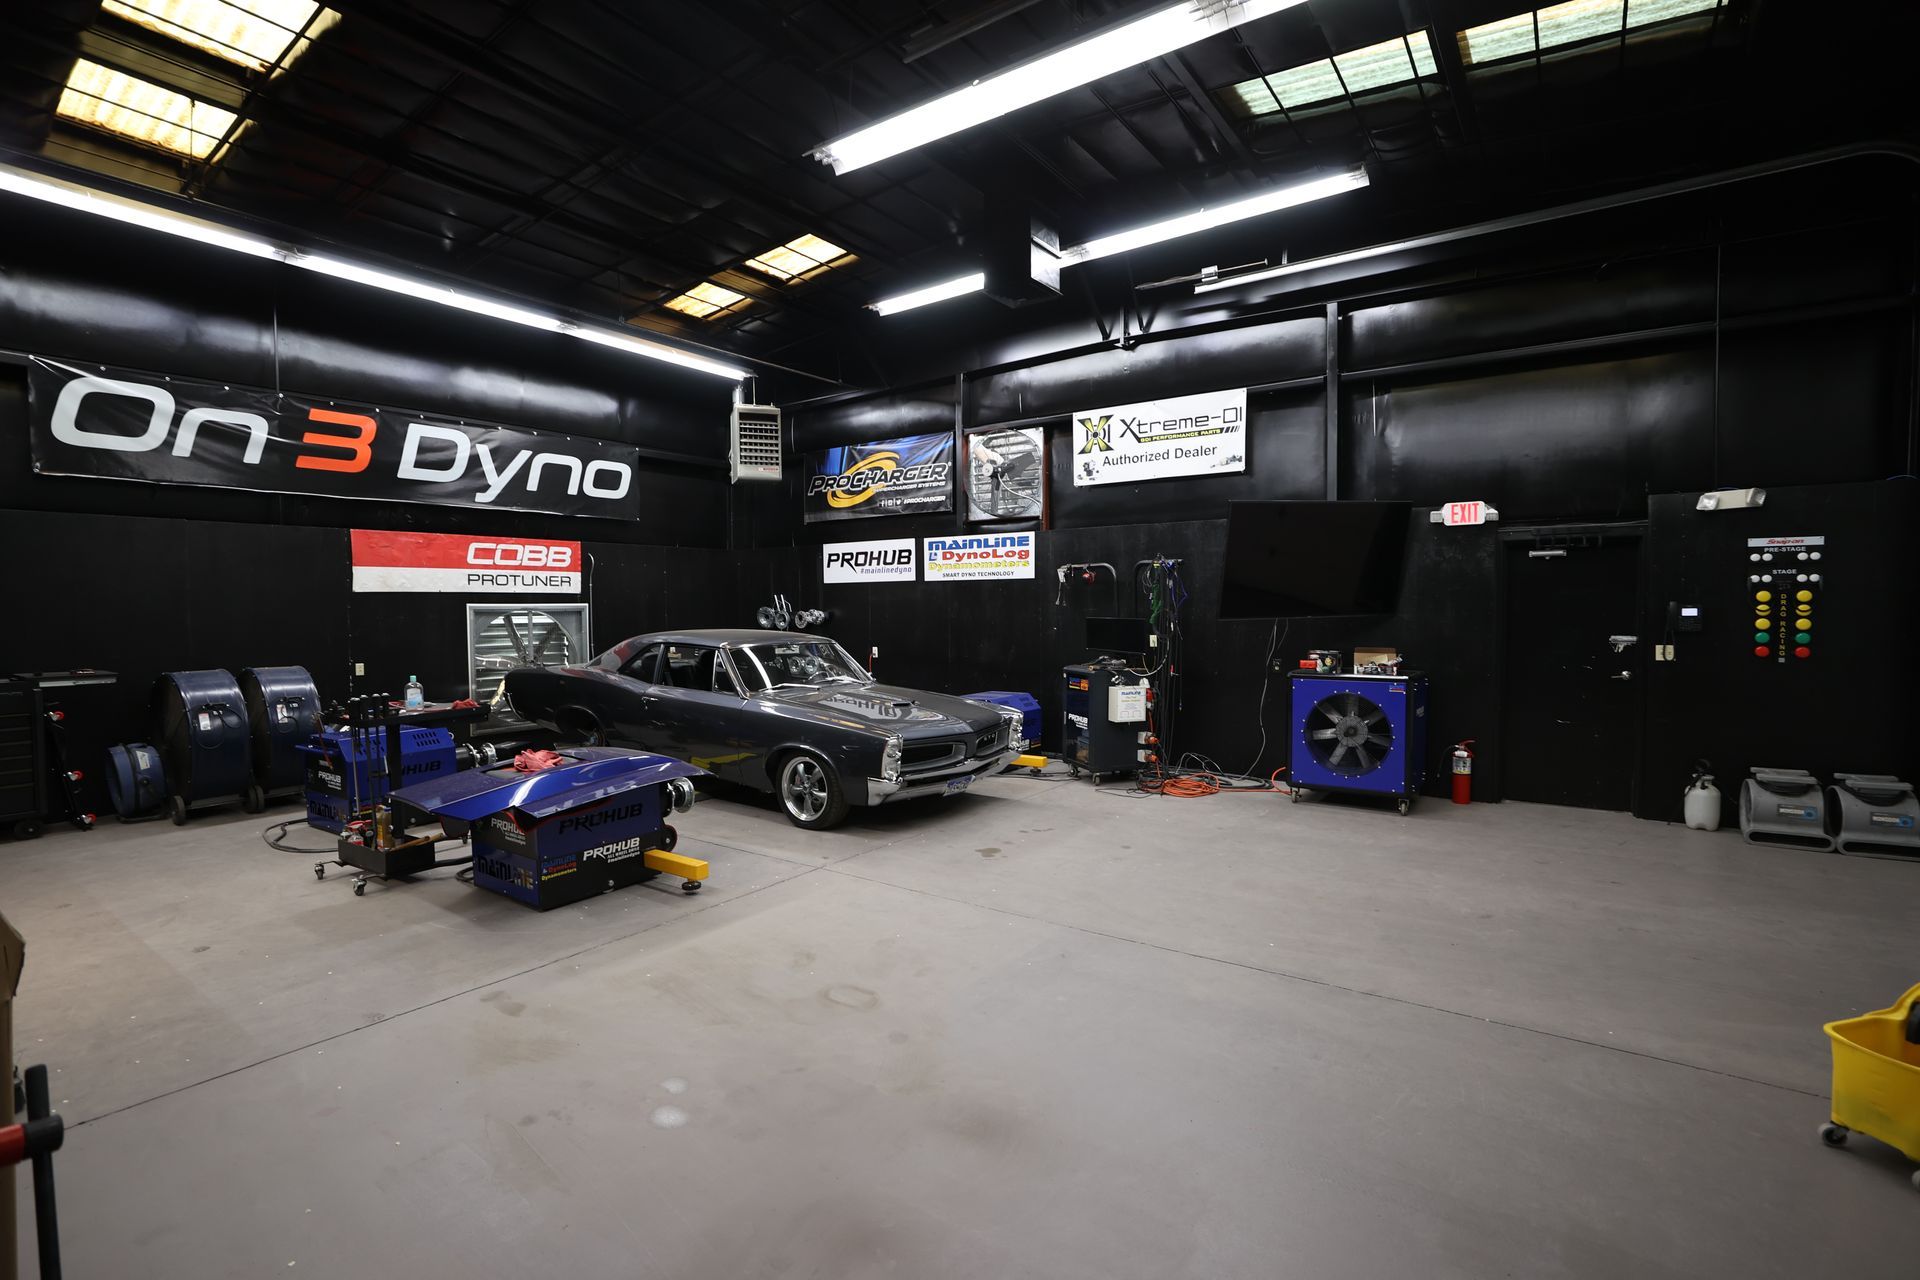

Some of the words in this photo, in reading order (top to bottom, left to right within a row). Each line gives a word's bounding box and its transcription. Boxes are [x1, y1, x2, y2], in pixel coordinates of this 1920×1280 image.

[51, 377, 269, 465] On
[295, 407, 380, 474] 3
[396, 422, 632, 503] Dyno
[1152, 431, 1199, 441] PERFORMANCE
[1200, 428, 1221, 436] PARTS
[1102, 449, 1170, 467] Authorized
[1174, 445, 1218, 460] Dealer
[1451, 503, 1480, 524] EXIT
[466, 542, 572, 567] COBB
[826, 549, 912, 574] PROHUB
[941, 549, 1030, 562] DynoLog
[860, 566, 912, 575] #mainlinedyno
[927, 560, 1030, 572] Dynamometers
[467, 573, 572, 587] PROTUNER
[1780, 593, 1788, 617] DRAG
[559, 803, 643, 835] PROHUB
[583, 837, 640, 861] PROHUB
